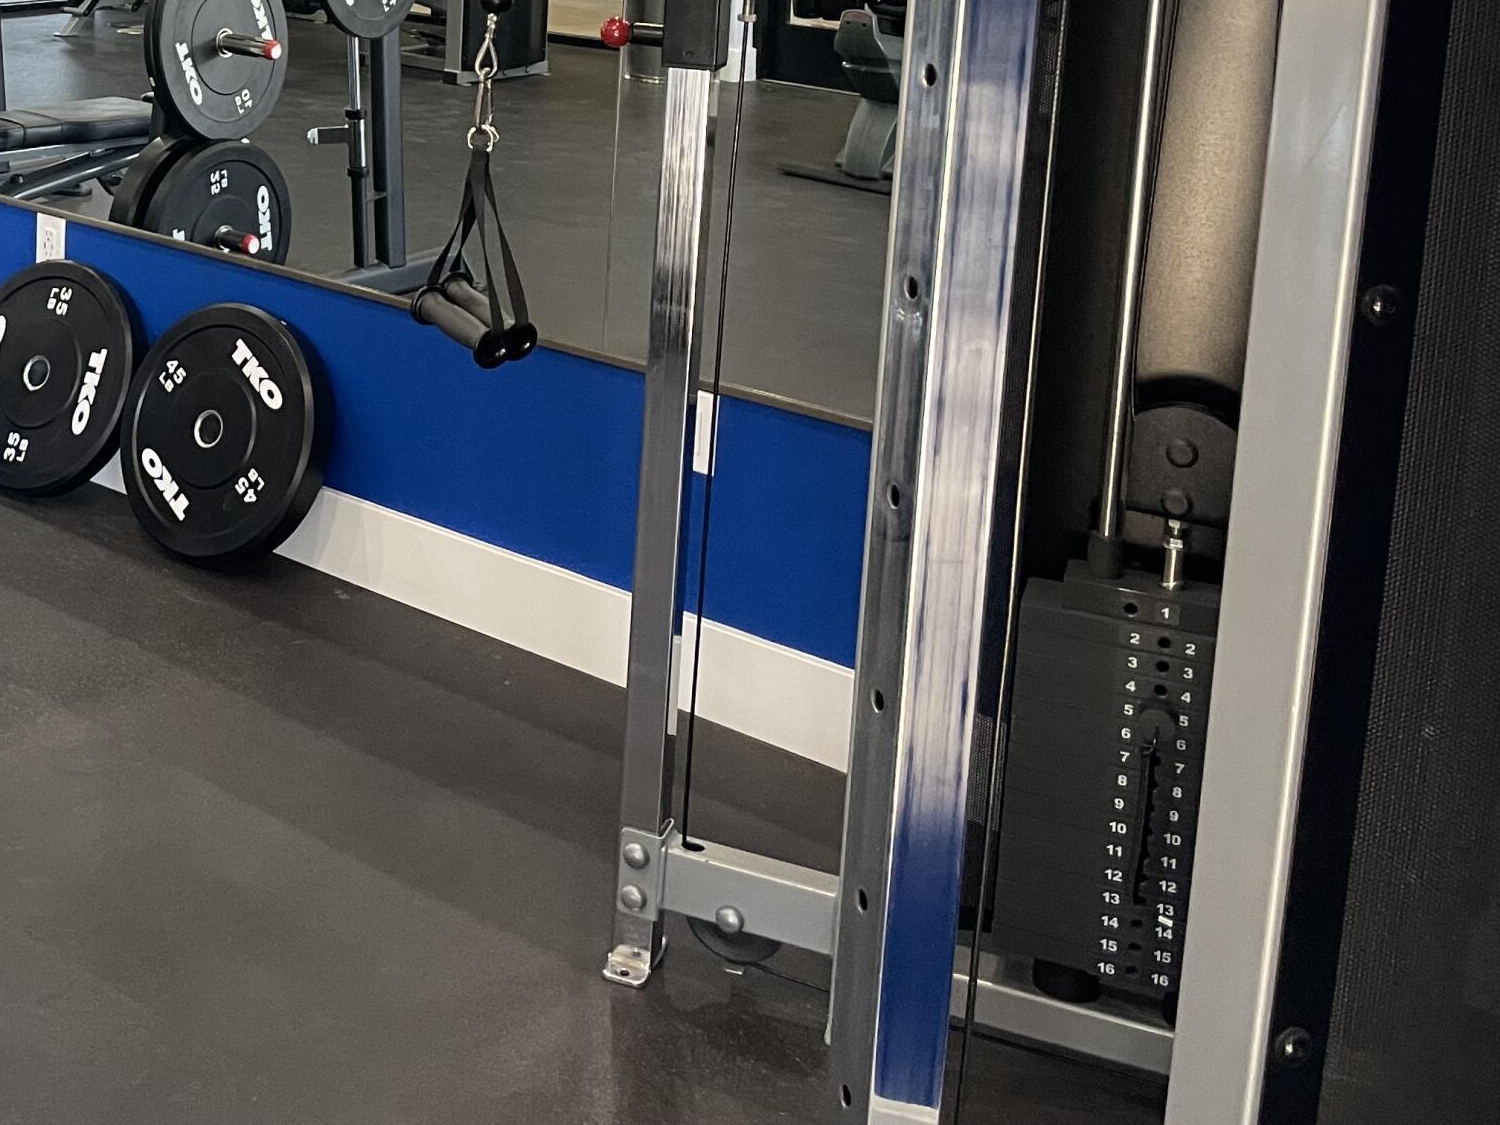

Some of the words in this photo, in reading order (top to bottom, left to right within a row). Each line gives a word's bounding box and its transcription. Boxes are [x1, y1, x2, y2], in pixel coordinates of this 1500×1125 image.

[47, 287, 60, 310] LB
[55, 286, 73, 316] 35
[158, 372, 175, 393] LB
[165, 358, 187, 385] 45
[230, 338, 283, 410] TKO
[71, 348, 108, 435] TKO
[3, 431, 20, 462] 35
[16, 438, 29, 463] LB
[141, 447, 189, 521] TKO
[234, 476, 257, 504] 45
[248, 468, 266, 492] LB
[1161, 607, 1170, 619] 1
[1130, 632, 1140, 645] 2
[1185, 643, 1196, 655] 2
[1127, 656, 1138, 669] 3
[1183, 667, 1193, 679] 3
[1125, 681, 1136, 692] 4
[1180, 692, 1191, 703] 4
[1123, 704, 1134, 716] 5
[1179, 714, 1189, 727] 5
[1121, 727, 1131, 739] 6
[1176, 739, 1186, 751] 6
[1119, 751, 1130, 763] 7
[1175, 762, 1185, 774] 7
[1117, 774, 1127, 786] 8
[1172, 786, 1182, 798] 8
[1114, 798, 1125, 810] 9
[1169, 810, 1179, 822] 9
[1109, 821, 1127, 834] 10
[1164, 833, 1182, 846] 10
[1106, 844, 1122, 857] 11
[1160, 856, 1177, 870] 11
[1104, 869, 1123, 882] 12
[1159, 880, 1177, 893] 12
[1102, 891, 1120, 905] 13
[1156, 903, 1174, 917] 13
[1101, 915, 1119, 929] 14
[1155, 927, 1174, 940] 14
[1100, 938, 1118, 952] 15
[1153, 950, 1171, 963] 15
[1097, 962, 1115, 975] 16
[1151, 973, 1169, 987] 16
